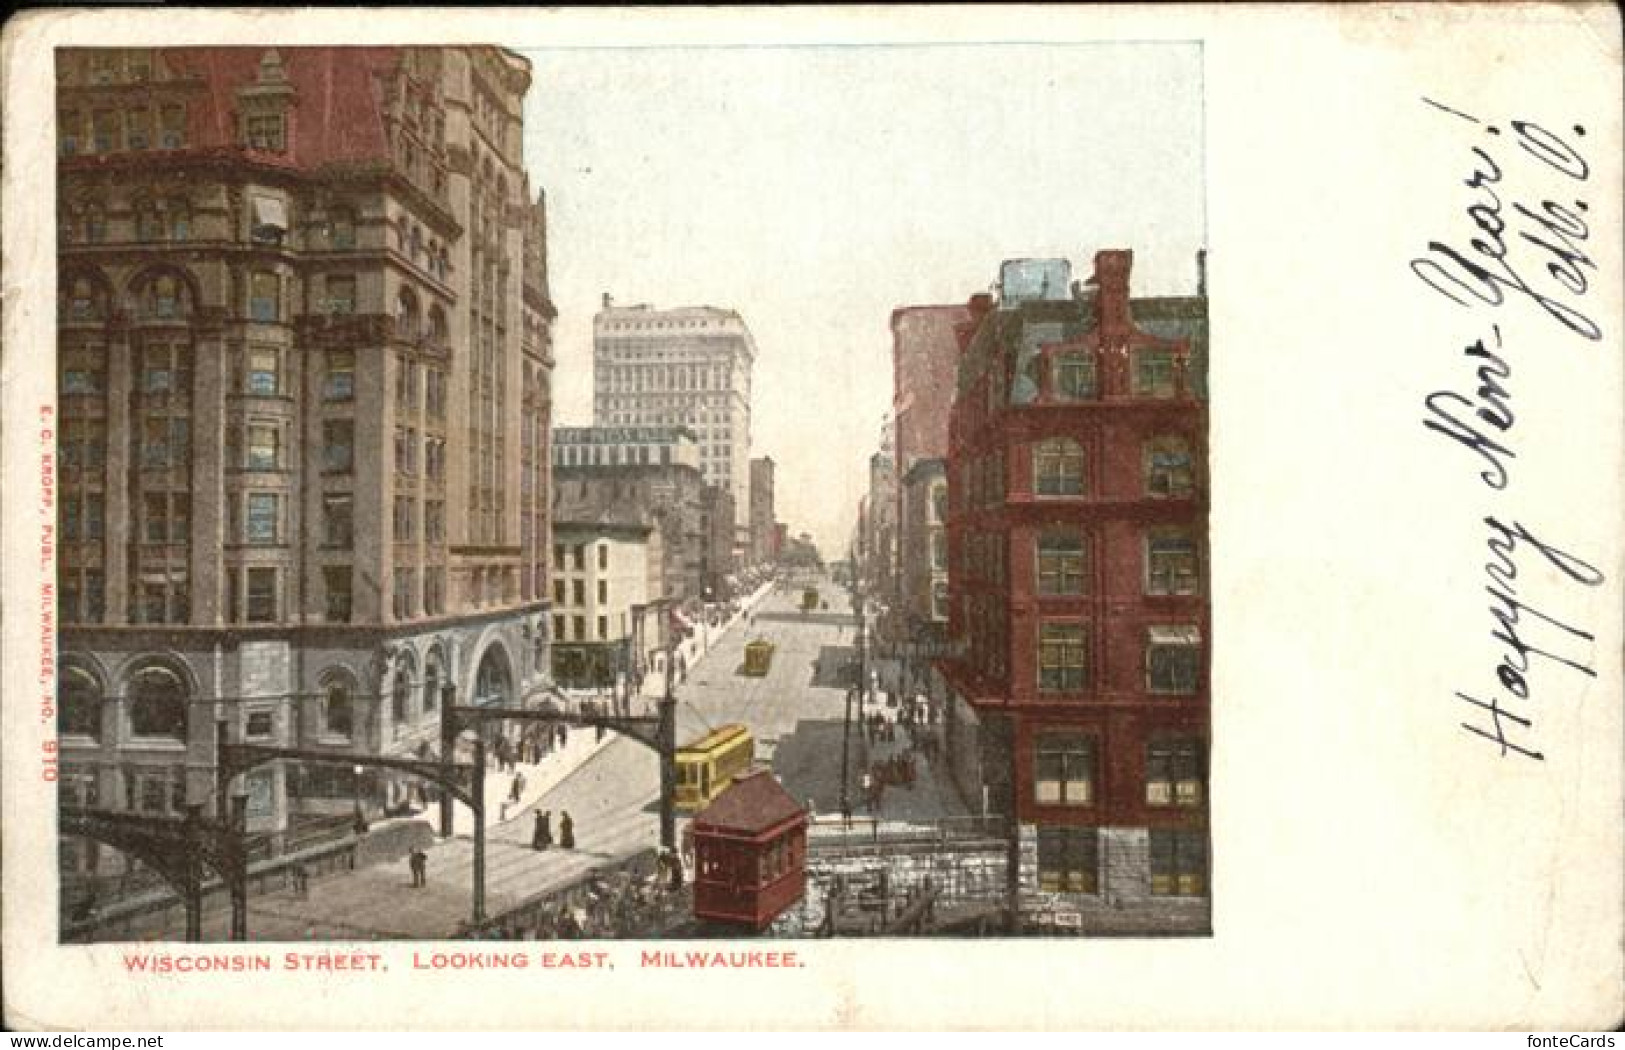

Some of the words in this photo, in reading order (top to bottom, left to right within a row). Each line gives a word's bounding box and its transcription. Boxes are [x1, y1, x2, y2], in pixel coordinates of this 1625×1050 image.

[1455, 515, 1605, 761] Happy
[42, 740, 58, 783] 910
[541, 950, 615, 970] EAST,
